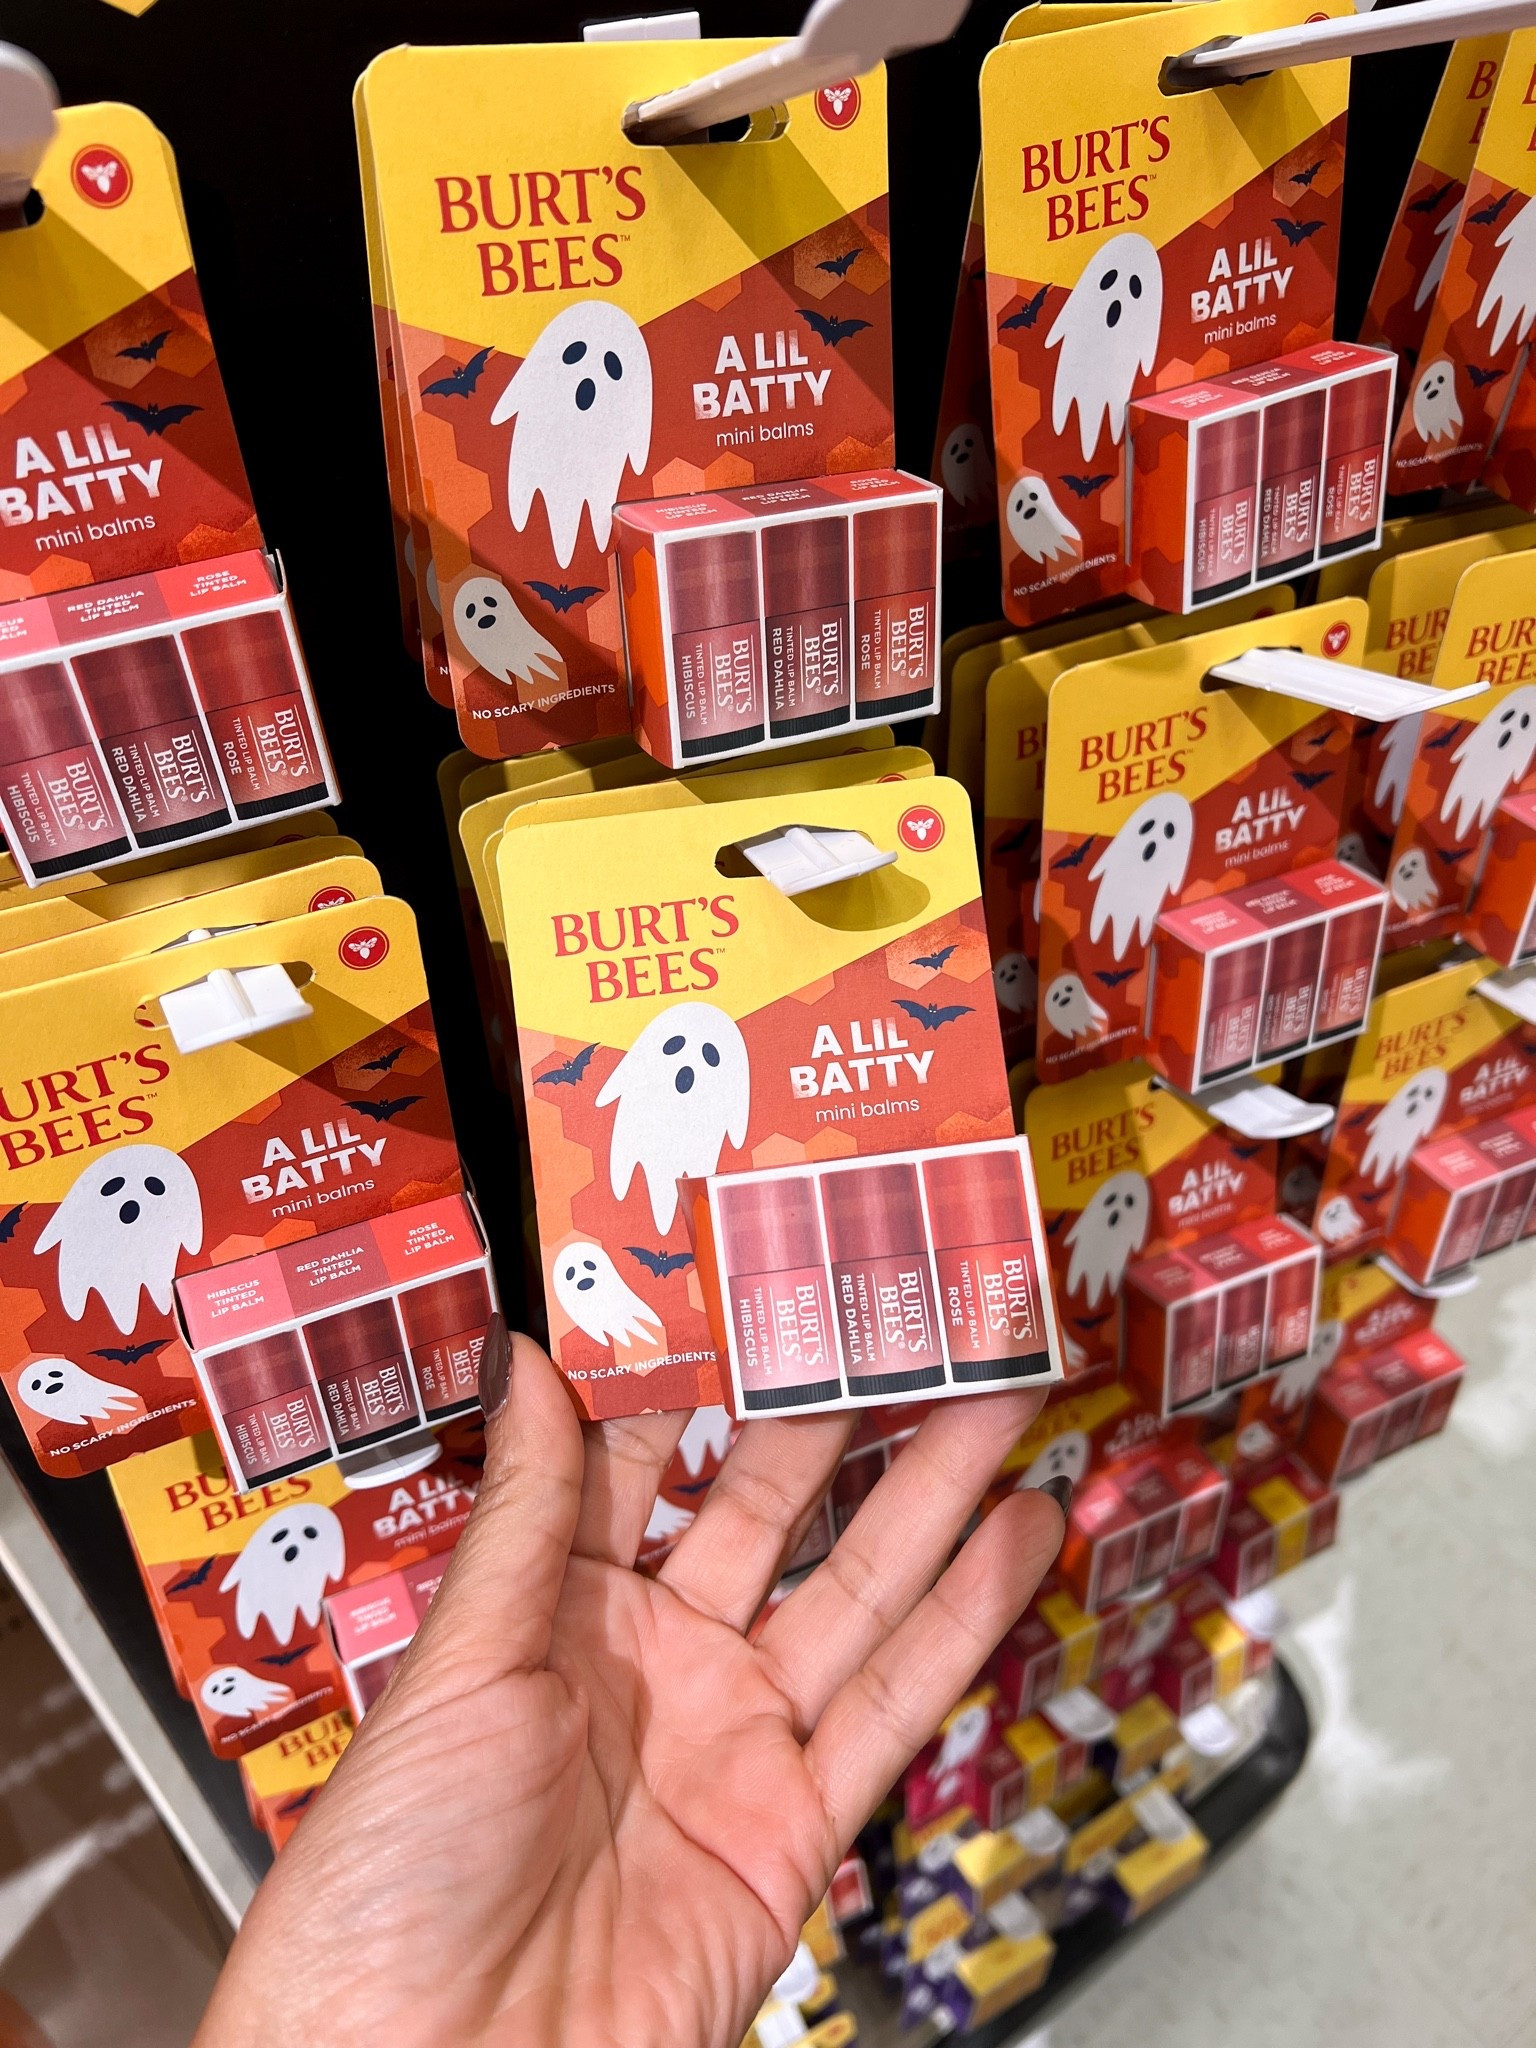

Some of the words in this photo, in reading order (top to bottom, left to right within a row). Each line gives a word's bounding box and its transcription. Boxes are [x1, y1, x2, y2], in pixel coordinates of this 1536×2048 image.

[1022, 115, 1170, 193] BURT'S
[434, 165, 645, 233] BURT'S
[1208, 248, 1232, 283] A
[1238, 236, 1277, 275] LIL
[1191, 266, 1294, 324] BATTY
[1204, 322, 1233, 344] mini
[1236, 314, 1276, 335] balms
[714, 335, 747, 374] A
[754, 329, 808, 370] LIL
[693, 369, 832, 420] BATTY
[16, 436, 55, 479] A
[56, 422, 131, 469] LIL
[716, 426, 754, 446] mini
[759, 422, 814, 441] balms
[0, 458, 162, 527] BATTY
[1359, 458, 1376, 522] BURT'S
[1296, 478, 1312, 543] BURT'S
[35, 525, 83, 551] mini
[87, 515, 156, 540] balms
[1233, 500, 1248, 564] BURT'S
[772, 627, 783, 655] RED
[786, 626, 794, 661] TINTED
[822, 621, 839, 696] BURT'S
[861, 633, 870, 670] ROSE
[908, 605, 924, 679] BURT'S
[695, 643, 705, 679] TINTED
[733, 639, 752, 714] BURT'S
[787, 663, 795, 678] LIP
[1476, 649, 1536, 686] BEE
[472, 710, 491, 719] NO
[494, 701, 535, 718] SCARY
[537, 684, 615, 708] INGREDIENTS
[682, 655, 696, 719] HIBISCUS
[698, 681, 706, 696] LIP
[774, 659, 785, 710] DAHLIA
[788, 680, 796, 707] BALM
[699, 698, 708, 725] BALM
[233, 717, 248, 750] TINTED
[274, 708, 309, 777] BURT'S
[1079, 706, 1208, 772] BURT'S
[129, 743, 145, 776] TINTED
[171, 734, 209, 803] BURT'S
[223, 741, 242, 775] ROSE
[242, 751, 253, 765] LIP
[66, 761, 107, 831] BURT'S
[112, 746, 129, 773] RED
[122, 775, 146, 822] DAHLIA
[140, 777, 151, 791] LIP
[247, 766, 260, 790] BALM
[8, 785, 40, 843] HIBISCUS
[21, 772, 40, 805] TINTED
[35, 806, 46, 820] LIP
[41, 821, 58, 846] BALM
[145, 792, 160, 817] BALM
[1231, 795, 1252, 824] A
[1257, 784, 1294, 816] LIL
[1215, 803, 1307, 854] BATTY
[551, 894, 739, 957] BURT'S
[811, 1024, 844, 1059] A
[850, 1016, 909, 1053] LIL
[0, 1044, 170, 1122] URT'S
[789, 1050, 934, 1099] BATTY
[815, 1103, 856, 1123] mini
[860, 1099, 920, 1118] balms
[262, 1136, 296, 1168] A
[301, 1118, 361, 1155] LIL
[1051, 1102, 1155, 1161] BURT'S
[241, 1137, 387, 1204] BATTY
[272, 1195, 312, 1217] mini
[317, 1179, 375, 1204] balms
[404, 1245, 421, 1255] LIP
[424, 1234, 455, 1249] BALM
[406, 1229, 446, 1245] TINTED
[409, 1222, 438, 1236] ROSE
[296, 1261, 319, 1273] RED
[322, 1246, 364, 1264] DAHLIA
[309, 1276, 327, 1286] LIP
[329, 1264, 361, 1280] BALM
[312, 1259, 353, 1275] TINTED
[207, 1279, 260, 1300] HIBISCUS
[215, 1289, 256, 1306] TINTED
[841, 1274, 854, 1304] RED
[857, 1273, 868, 1311] TINTED
[960, 1260, 972, 1298] TINTED
[211, 1306, 229, 1318] LIP
[231, 1295, 264, 1312] BALM
[754, 1287, 766, 1325] TINTED
[898, 1271, 927, 1353] BURT'S
[948, 1286, 963, 1327] ROSE
[966, 1301, 975, 1316] LIP
[1003, 1258, 1032, 1340] BURT'S
[739, 1299, 758, 1367] HIBISCUS
[759, 1327, 768, 1342] LIP
[795, 1284, 824, 1366] BURT'S
[845, 1308, 862, 1365] DAHLIA
[862, 1314, 871, 1329] LIP
[969, 1319, 980, 1349] BALM
[568, 1370, 588, 1380] NO
[590, 1364, 632, 1379] SCARY
[635, 1351, 716, 1371] INGREDIENTS
[761, 1345, 772, 1375] BALM
[864, 1332, 876, 1361] BALM
[327, 1383, 340, 1402] RED
[379, 1365, 405, 1415] BURT'S
[422, 1366, 436, 1390] ROSE
[50, 1446, 70, 1456] NO
[72, 1429, 114, 1450] SCARY
[117, 1399, 197, 1433] INGREDIENTS
[286, 1399, 316, 1448] BURT'S
[333, 1403, 350, 1436] DAHLIA
[235, 1424, 257, 1464] HIBISCUS
[388, 1487, 416, 1514] A
